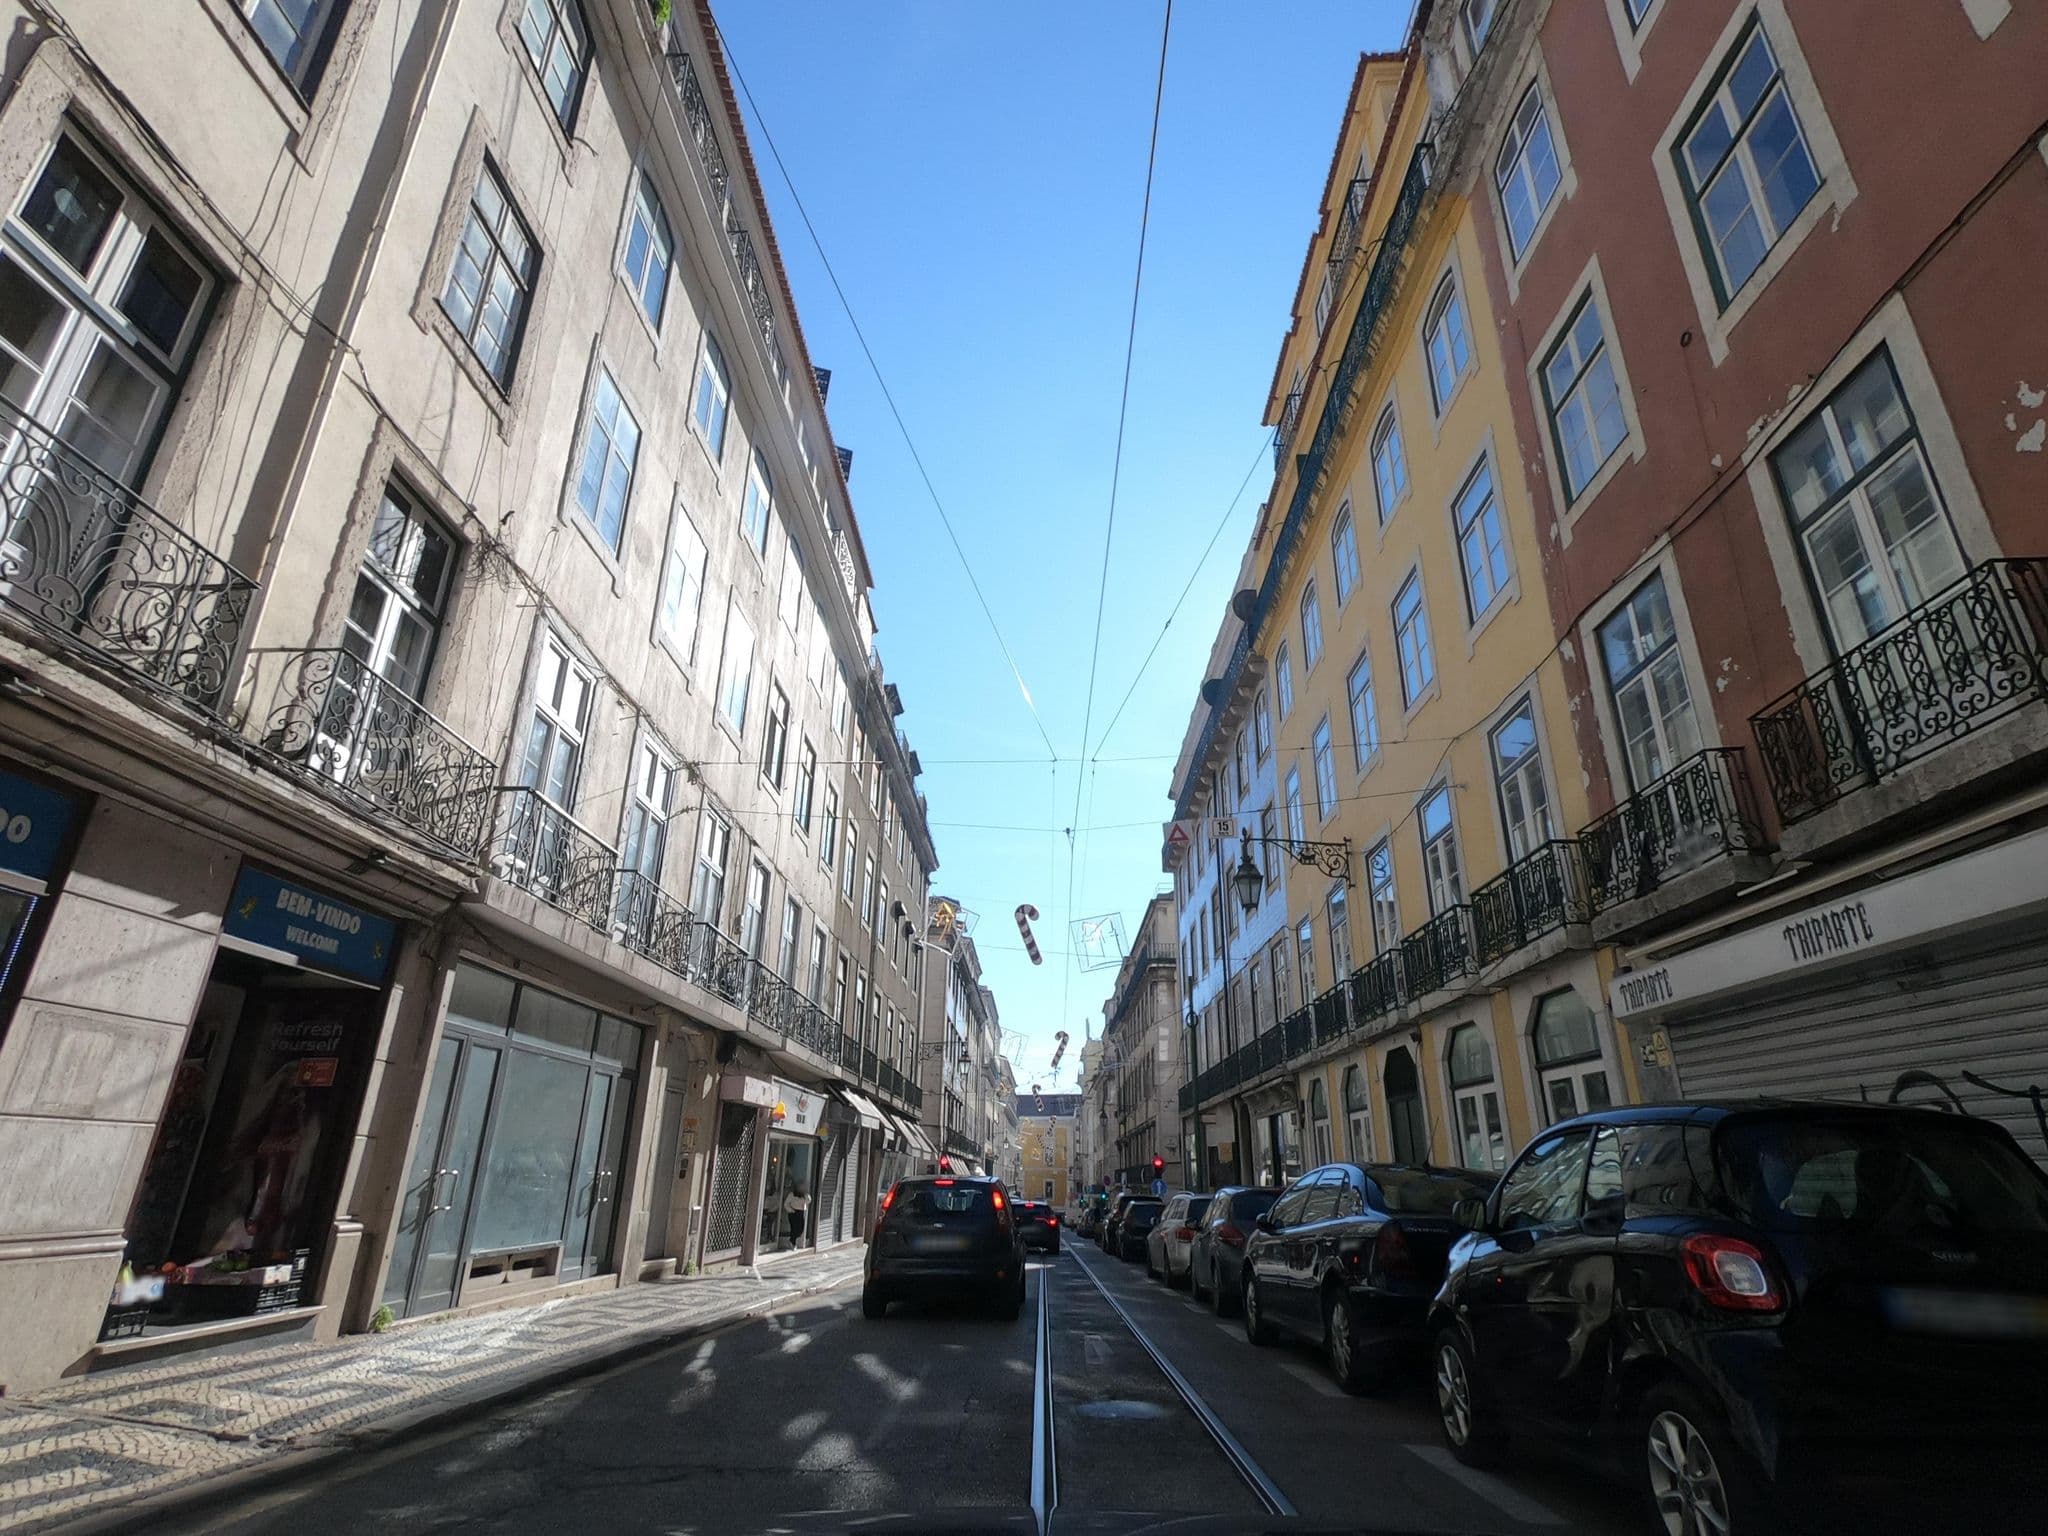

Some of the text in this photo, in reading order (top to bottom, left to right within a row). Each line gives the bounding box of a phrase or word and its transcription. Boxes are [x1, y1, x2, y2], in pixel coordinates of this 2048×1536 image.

[1217, 821, 1229, 832] 15
[276, 888, 361, 935] BEM-VINDO
[1783, 902, 1874, 961] TRIPARTE
[285, 925, 340, 954] WELCOME
[1619, 967, 1673, 1012] TRIPARTE
